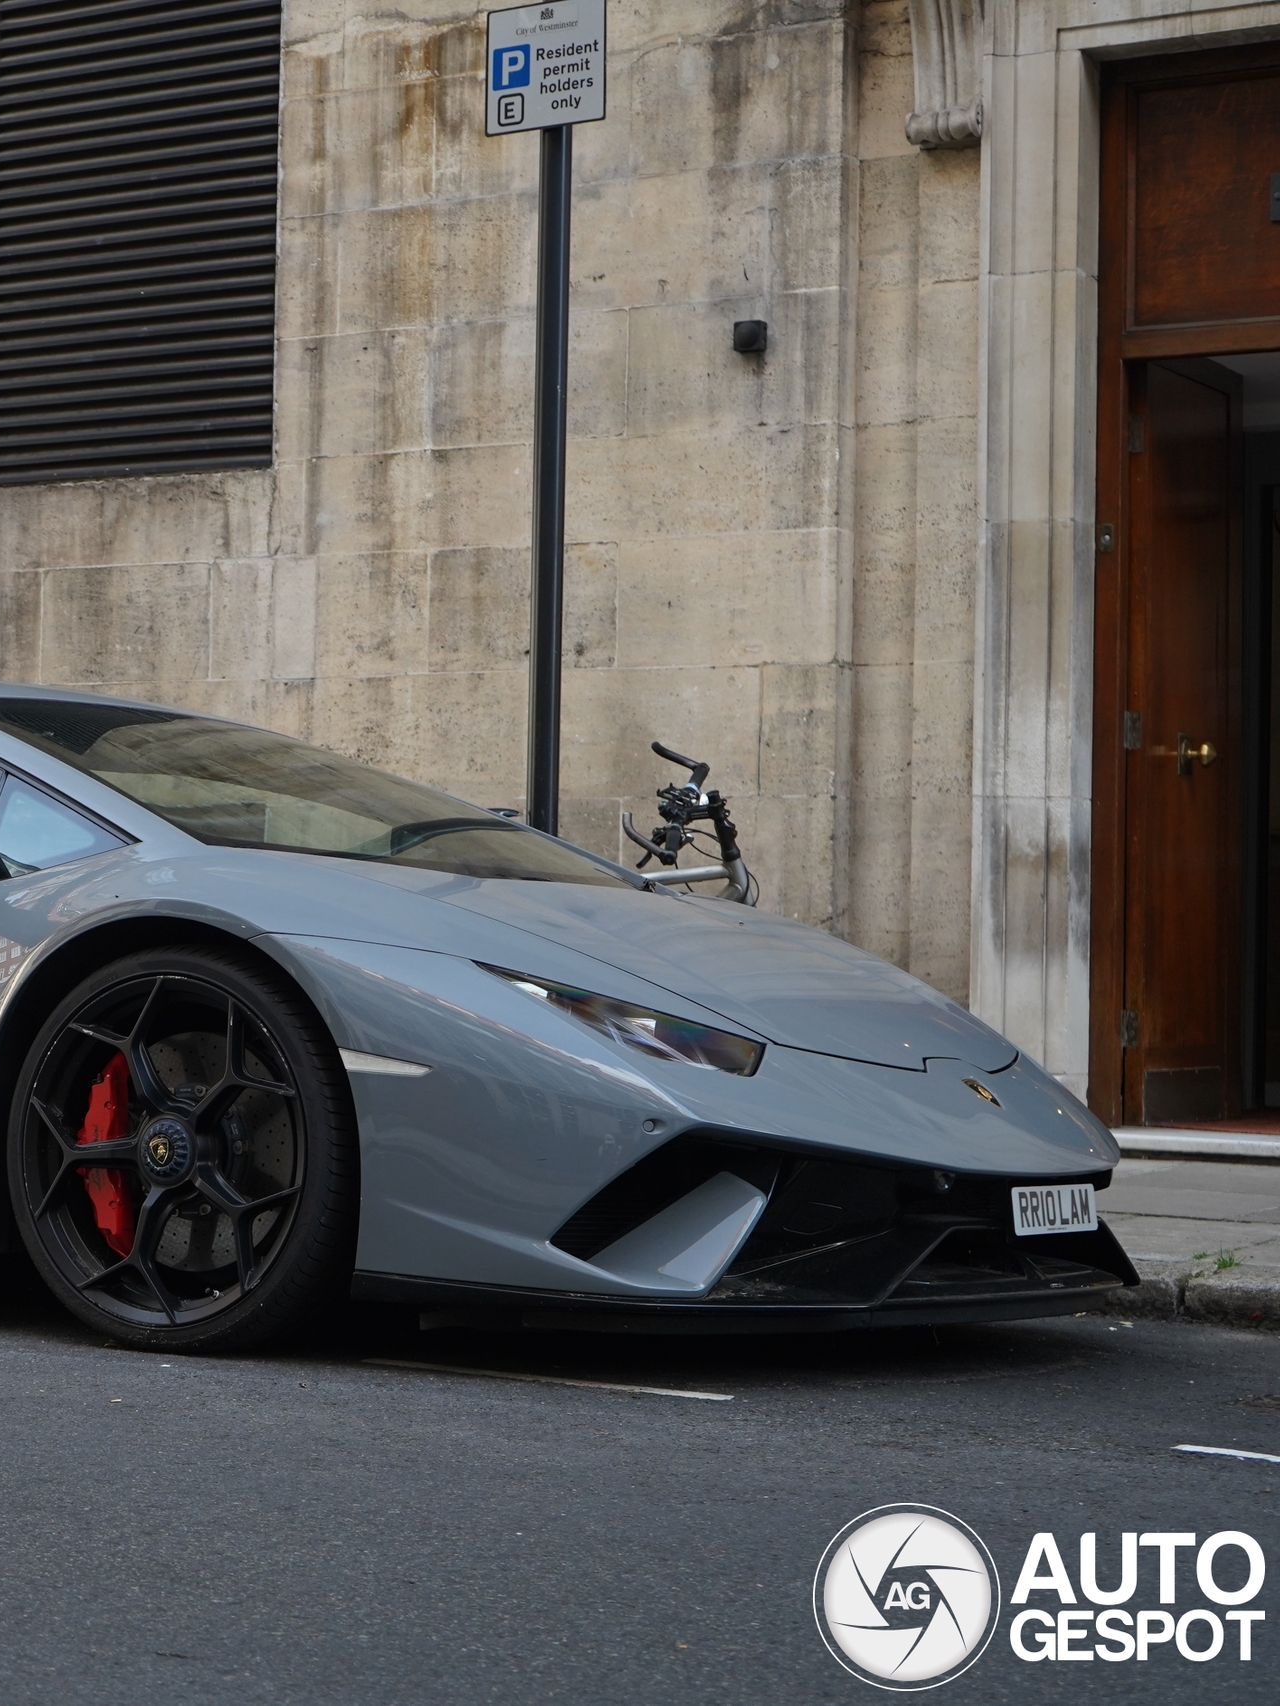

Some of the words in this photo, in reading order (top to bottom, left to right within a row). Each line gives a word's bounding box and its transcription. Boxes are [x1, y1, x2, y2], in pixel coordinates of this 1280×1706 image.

[515, 27, 528, 36] City
[530, 25, 537, 34] of
[538, 19, 578, 32] Westminster
[536, 39, 599, 61] Resident
[502, 50, 525, 86] P
[543, 58, 590, 79] permit
[540, 77, 593, 94] holders
[504, 101, 515, 120] E
[551, 94, 582, 110] only
